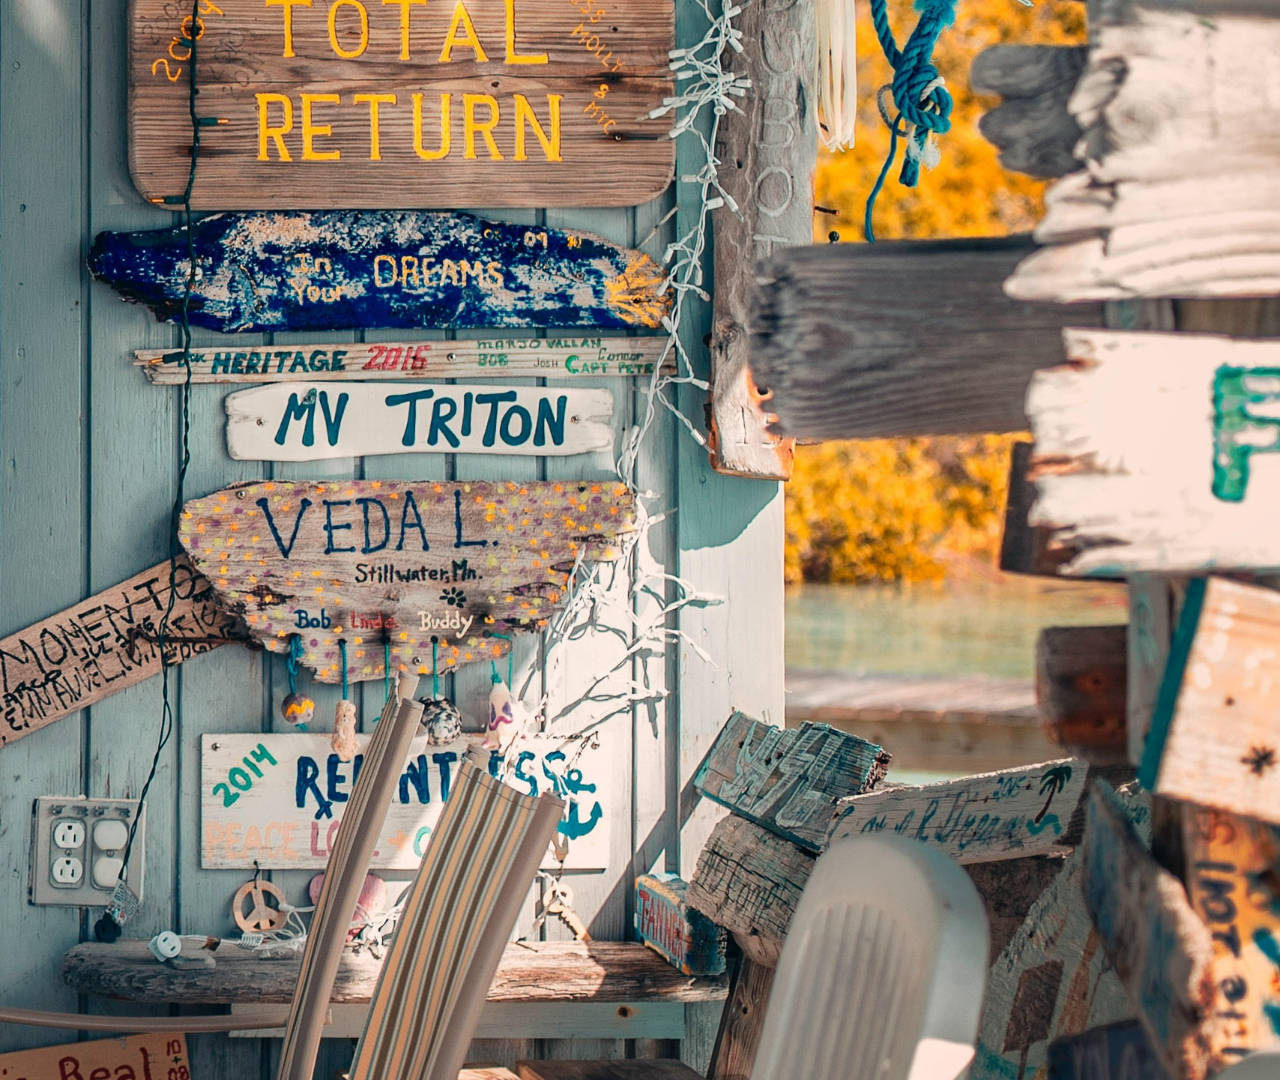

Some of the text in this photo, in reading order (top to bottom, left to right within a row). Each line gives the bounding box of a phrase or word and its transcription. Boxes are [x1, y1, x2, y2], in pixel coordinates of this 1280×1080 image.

[254, 92, 563, 162] RETURN
[372, 254, 505, 291] DREAMS
[210, 344, 433, 377] HERITAGE 2016
[274, 388, 569, 450] MV TRITON
[256, 489, 432, 560] VEDA
[293, 609, 332, 632] Bob
[418, 609, 474, 638] Buddy
[211, 742, 278, 809] 2014
[205, 820, 299, 860] PEACE
